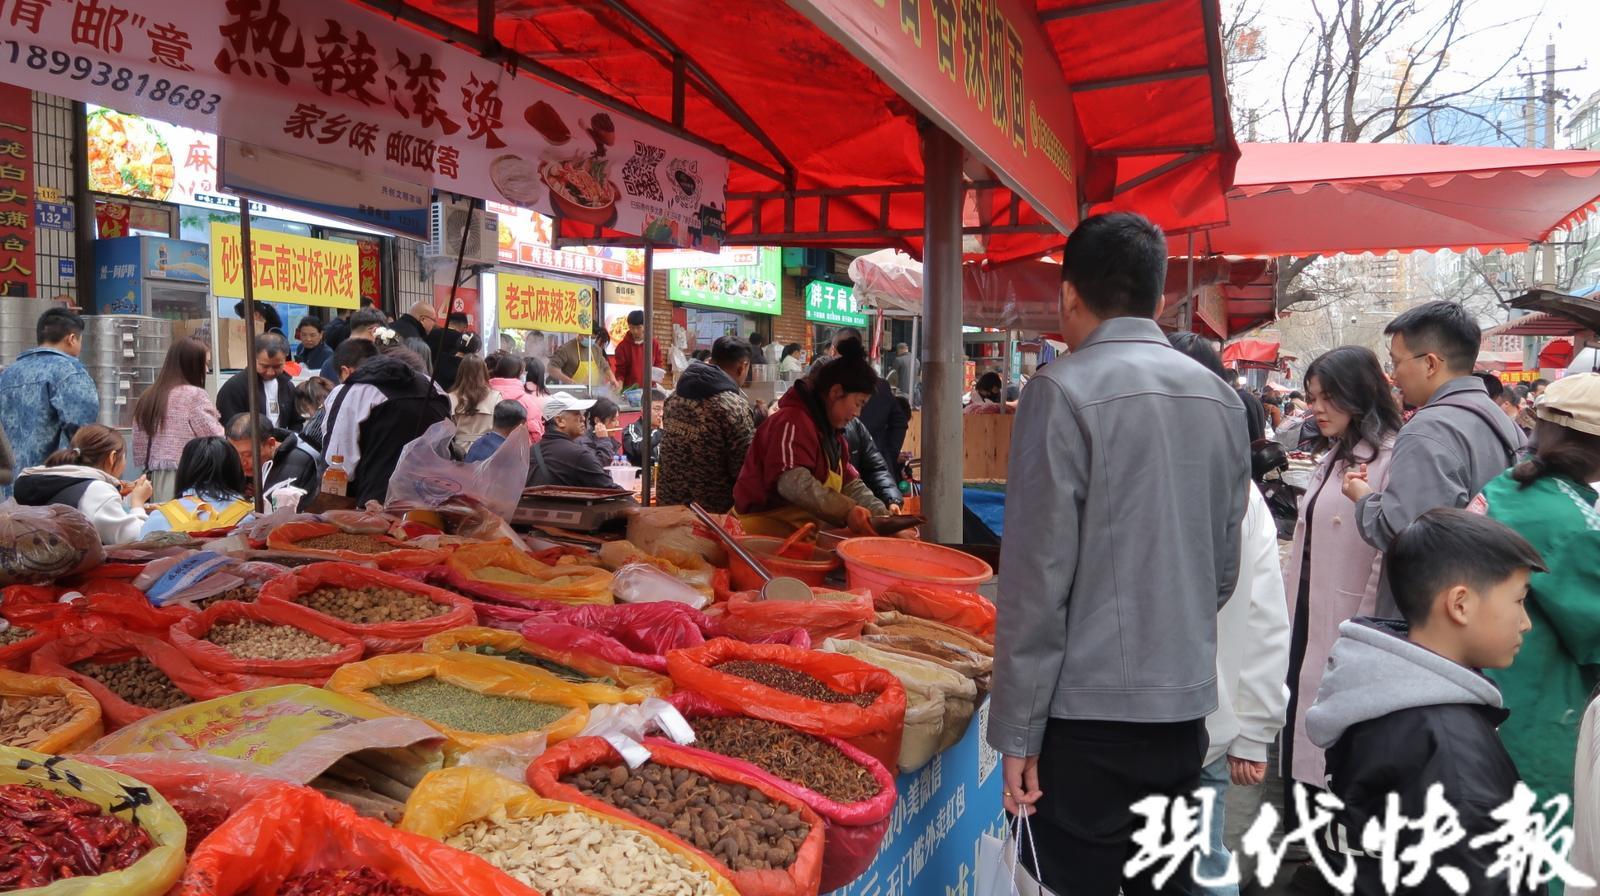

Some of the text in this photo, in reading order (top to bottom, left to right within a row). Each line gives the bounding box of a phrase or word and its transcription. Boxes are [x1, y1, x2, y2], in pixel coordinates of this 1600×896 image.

[8, 40, 222, 115] 18993818683
[214, 0, 507, 149] 热辣滚烫
[283, 103, 460, 180] 家乡味 邮政寄
[39, 211, 62, 225] 132
[505, 282, 577, 325] 老式麻辣烫
